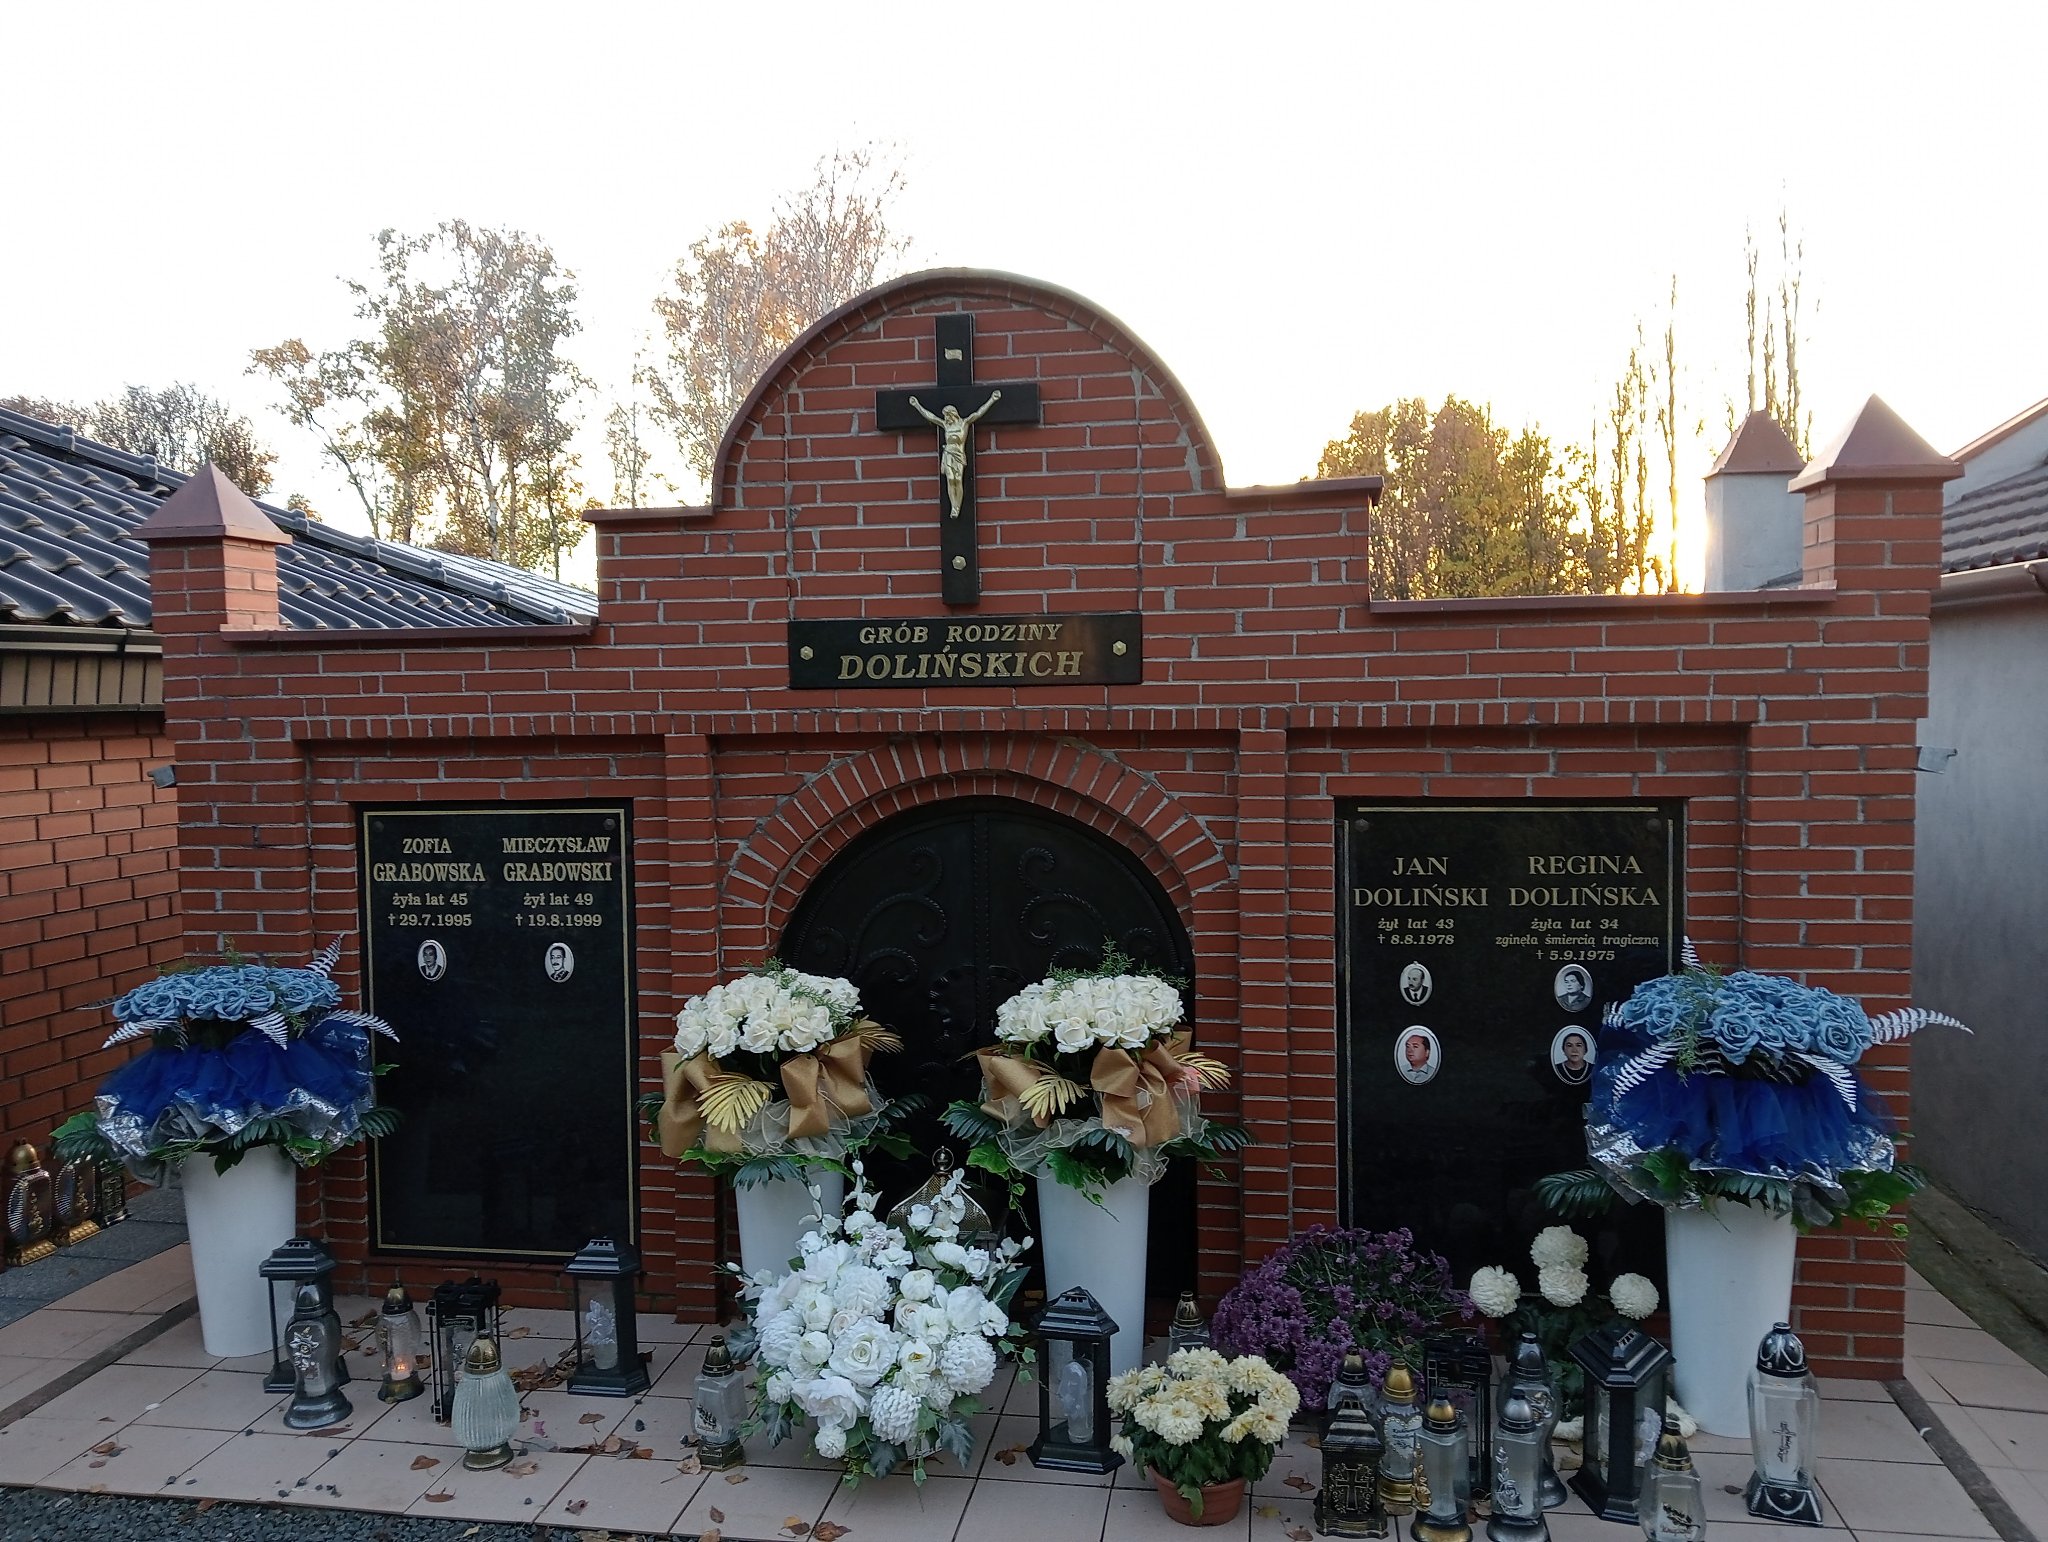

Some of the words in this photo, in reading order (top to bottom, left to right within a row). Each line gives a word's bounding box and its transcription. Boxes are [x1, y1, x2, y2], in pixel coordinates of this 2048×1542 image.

[859, 621, 929, 644] GRÓB
[947, 623, 1063, 643] RODZINY
[837, 646, 1084, 680] DOLIŃSKICH
[402, 838, 453, 854] ZOFIA
[502, 837, 611, 854] MIECZYSŁAW
[373, 862, 486, 882] GRABOWSKA
[503, 862, 613, 882] GRABOWSKI
[1392, 856, 1449, 876] JAN
[1528, 855, 1644, 875] REGINA
[392, 892, 422, 909] żyła
[425, 892, 445, 906] lat
[449, 893, 468, 906] 45
[523, 892, 546, 909] żył
[549, 892, 570, 906] lat
[574, 893, 594, 906] 49
[1353, 884, 1489, 907] DOLIŃSKI
[1508, 883, 1661, 907] DOLIŃSKA
[399, 913, 472, 927] 29.7.1995
[528, 913, 603, 927] 19.8.1999
[1377, 917, 1399, 932] żył
[1407, 918, 1429, 929] lat
[1435, 918, 1455, 930] 43
[1530, 918, 1563, 932] żyła
[1570, 918, 1592, 930] lat
[1599, 918, 1620, 930] 34
[1390, 934, 1455, 945] 8.8.1978
[1495, 933, 1539, 948] zginęła
[1544, 933, 1596, 948] śmiercią
[1602, 933, 1660, 948] tragiczną
[1549, 950, 1616, 961] 5.9.1975
